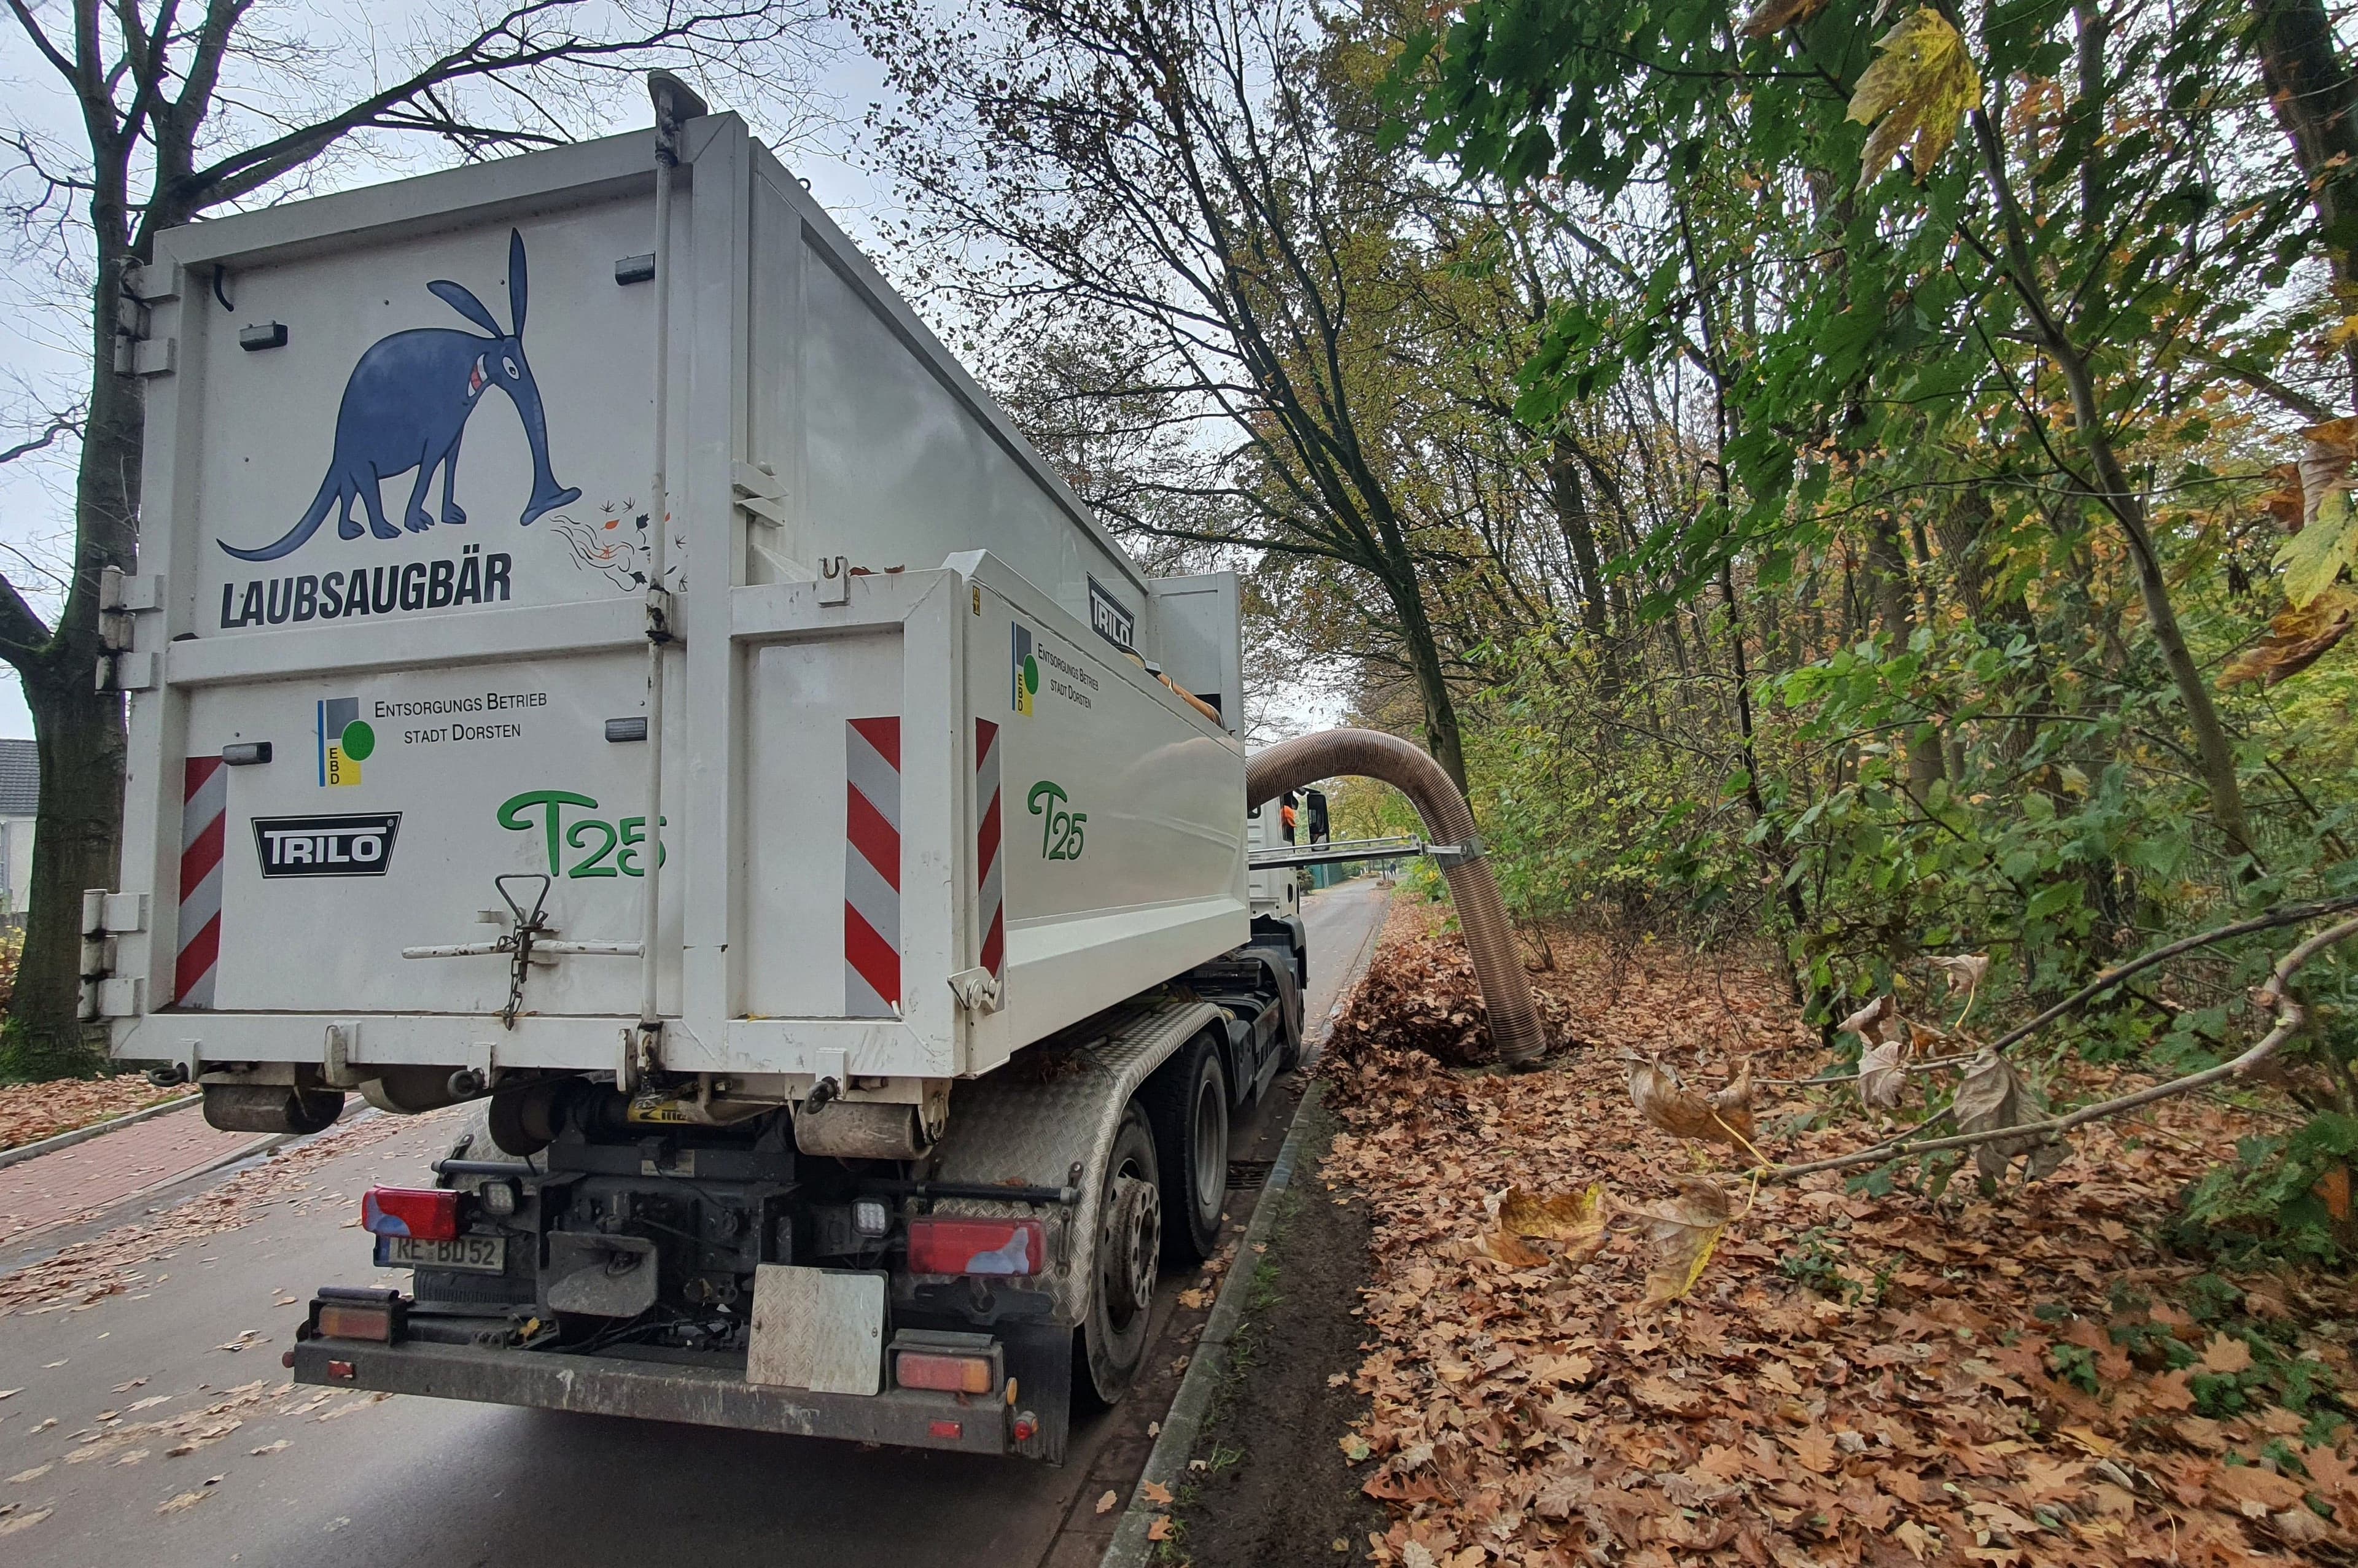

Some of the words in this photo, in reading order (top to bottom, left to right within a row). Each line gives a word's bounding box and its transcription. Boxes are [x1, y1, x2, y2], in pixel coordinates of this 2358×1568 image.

[220, 543, 512, 629] LAUBSAUGBÄR
[1091, 589, 1131, 646] TRILO
[263, 826, 387, 864] TRILO
[496, 790, 667, 878] T25
[1027, 780, 1087, 860] T25
